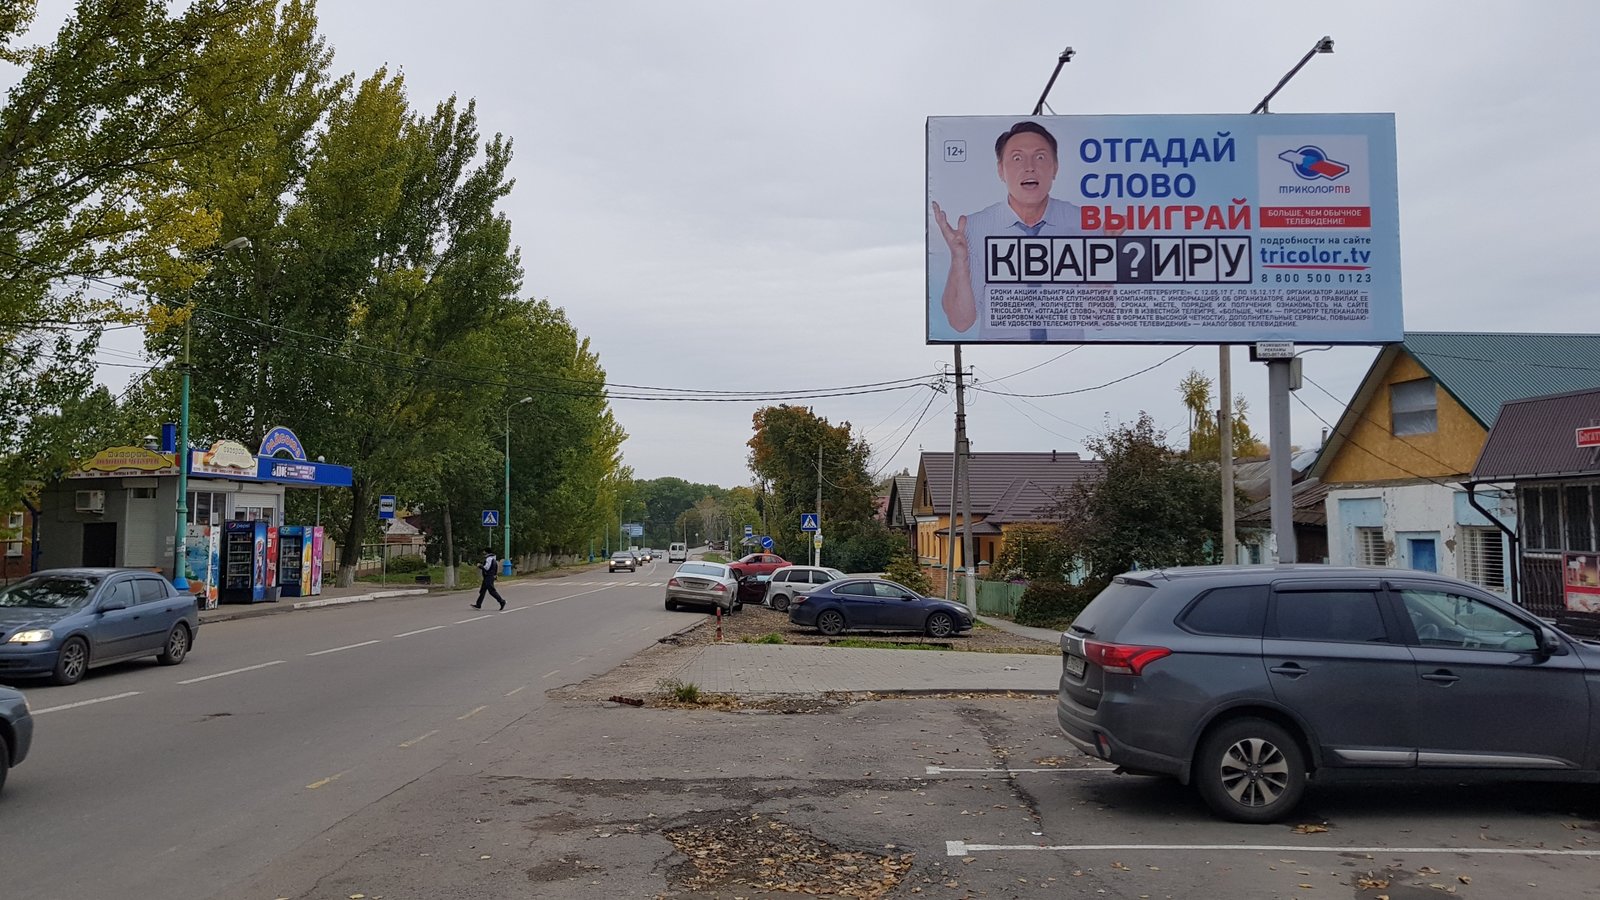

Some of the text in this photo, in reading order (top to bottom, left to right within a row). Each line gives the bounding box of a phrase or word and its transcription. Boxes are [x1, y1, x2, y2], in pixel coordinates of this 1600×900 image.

[947, 146, 964, 156] 12+
[1080, 131, 1236, 168] ОТГАДАЙ
[1080, 173, 1196, 198] СЛОВО
[1080, 198, 1250, 230] ВЫИГРАЙ
[1260, 236, 1325, 246] подробности
[1260, 245, 1371, 263] tricolor.tv
[1261, 274, 1371, 283] 8 800 500 0123
